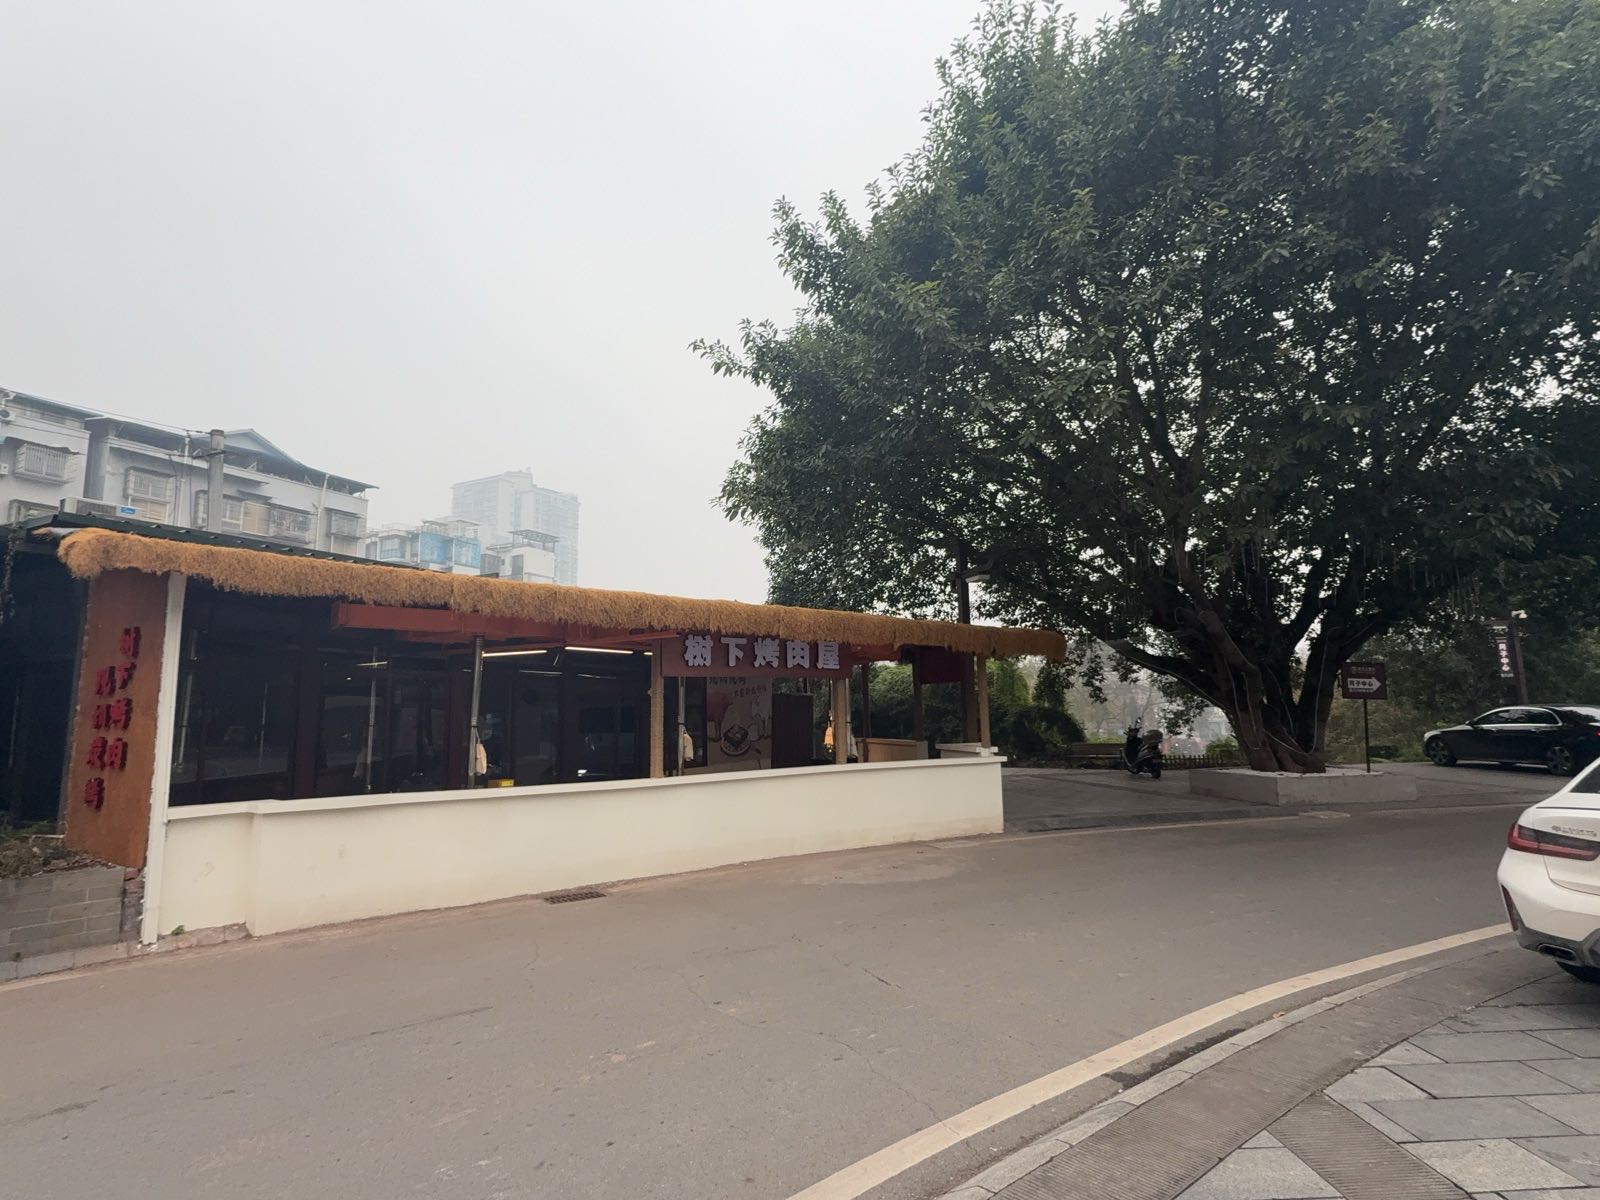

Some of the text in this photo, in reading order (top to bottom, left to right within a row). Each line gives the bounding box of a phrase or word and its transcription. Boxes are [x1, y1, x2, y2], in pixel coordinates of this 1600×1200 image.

[684, 634, 840, 670] 树下烤肉屋
